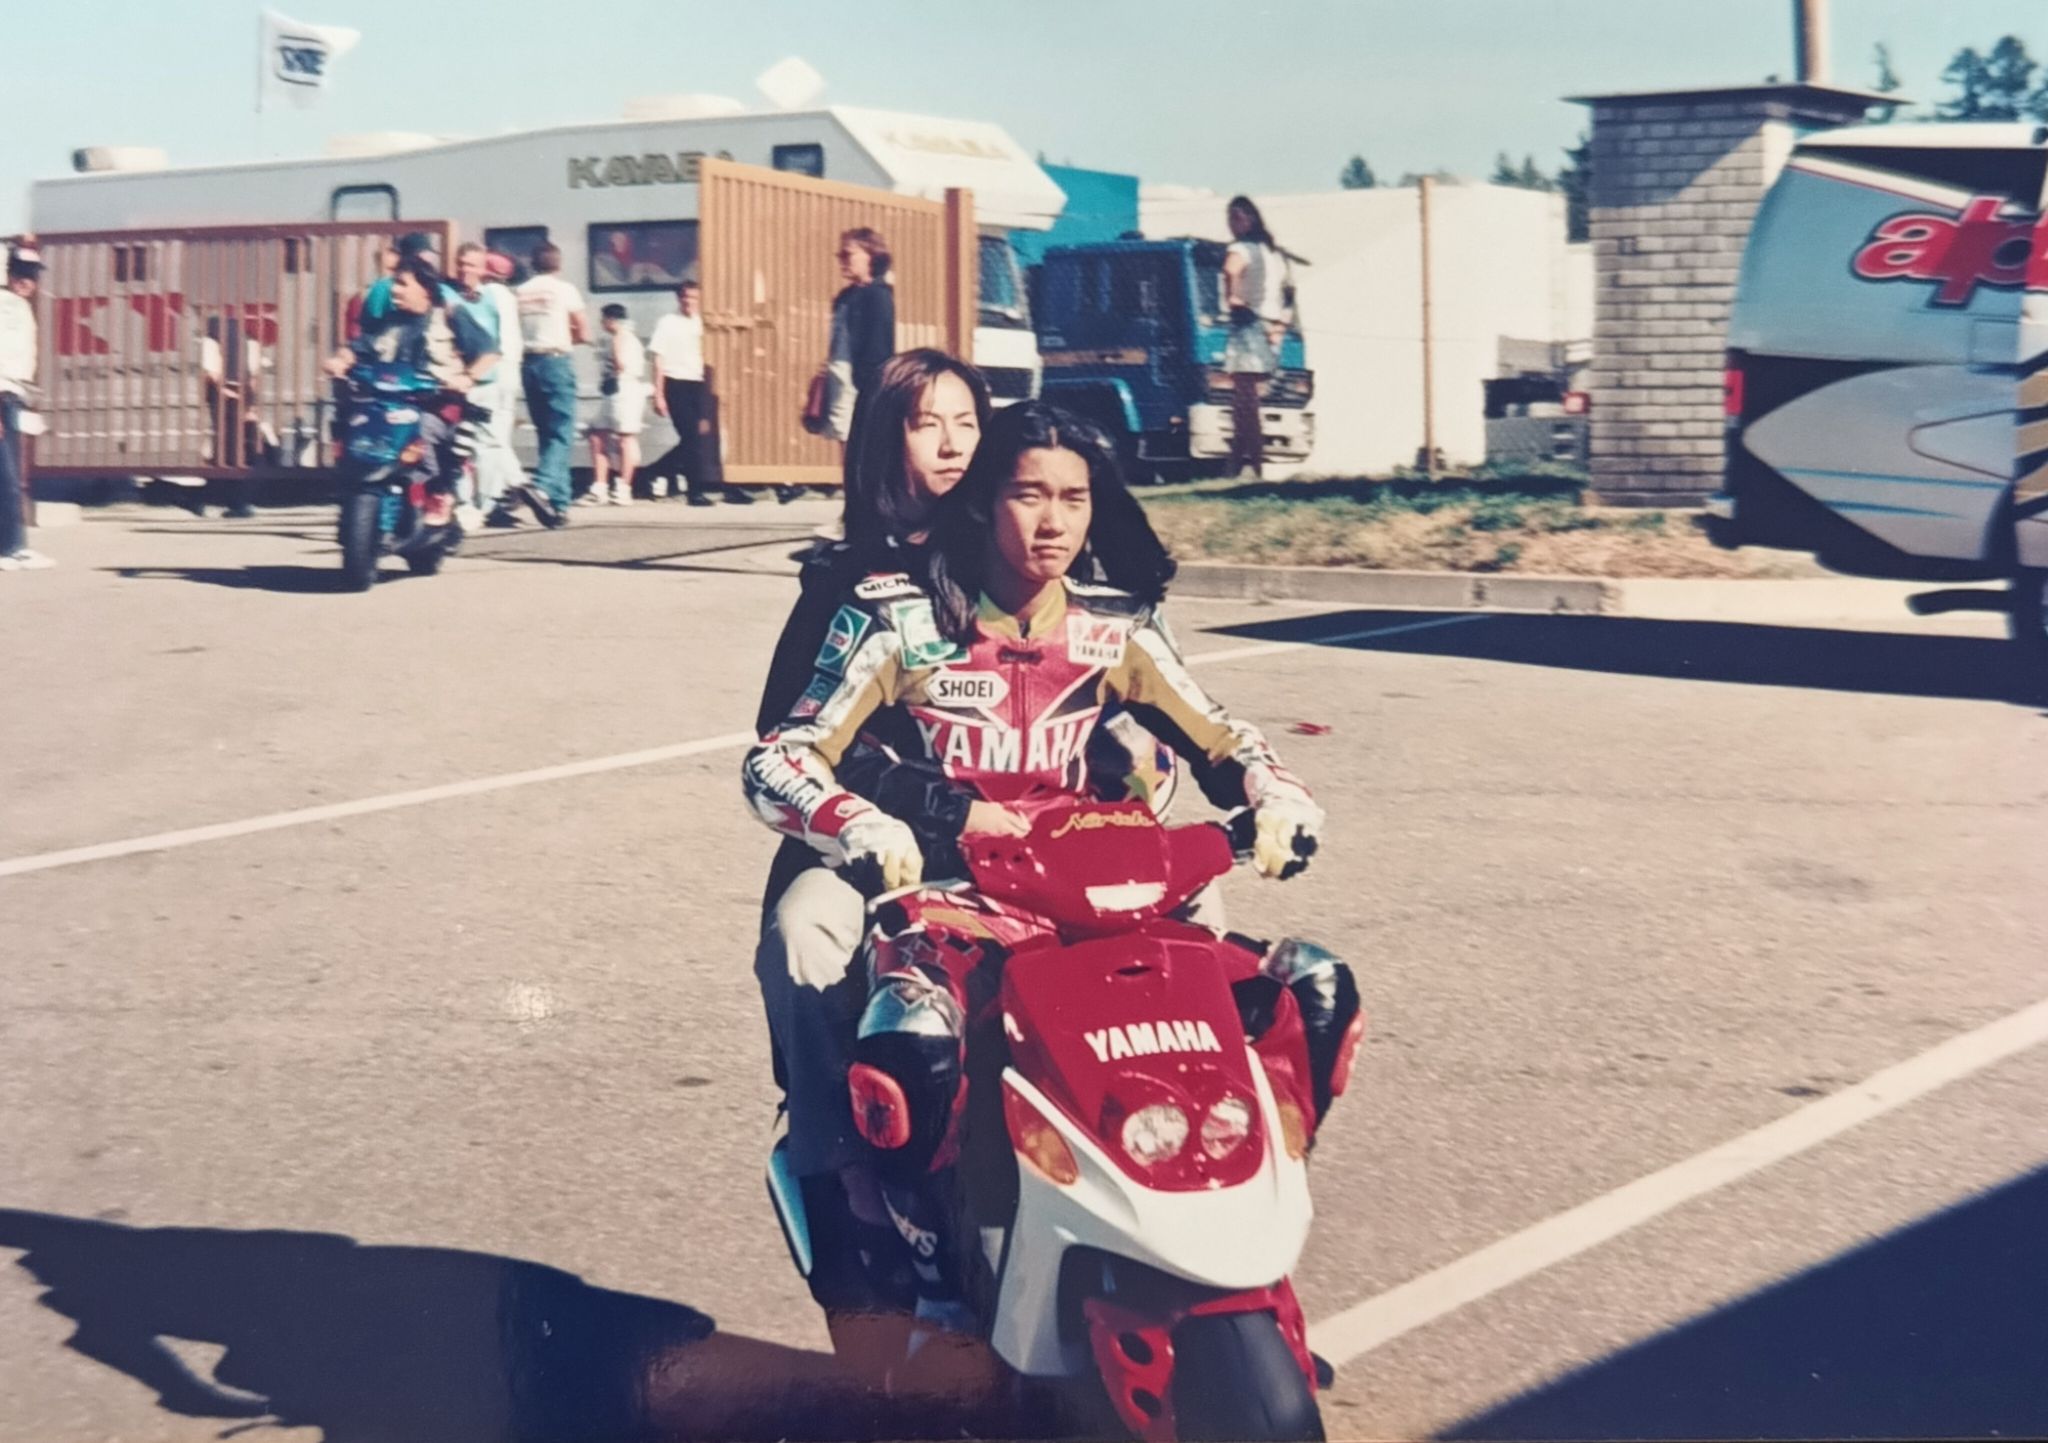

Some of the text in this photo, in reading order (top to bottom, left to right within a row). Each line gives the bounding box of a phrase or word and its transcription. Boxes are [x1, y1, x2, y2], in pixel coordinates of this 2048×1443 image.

[567, 151, 734, 189] KAYAB
[938, 680, 994, 698] SHOEI
[1083, 1020, 1222, 1062] YAMAHA
